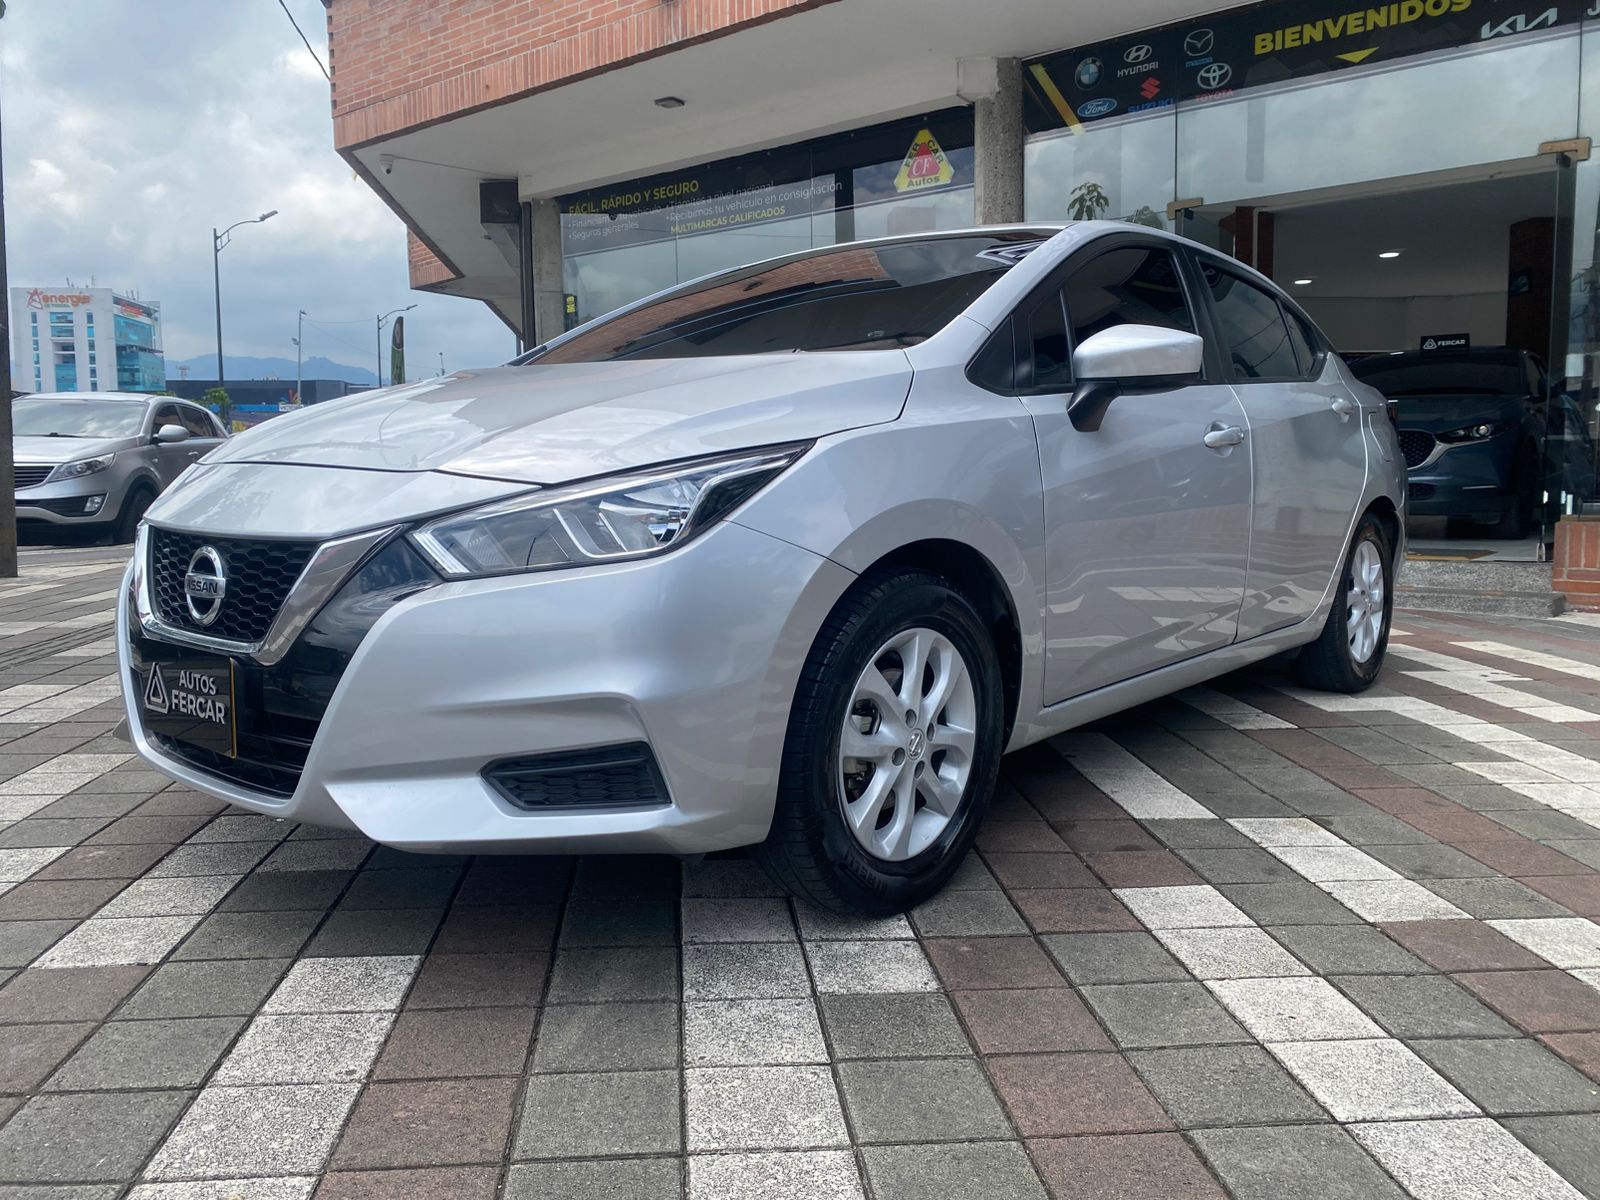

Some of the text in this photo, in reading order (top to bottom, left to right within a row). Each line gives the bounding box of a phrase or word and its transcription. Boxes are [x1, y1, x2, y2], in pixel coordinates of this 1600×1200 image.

[1254, 0, 1472, 55] BIENVENIDOS
[1117, 61, 1159, 78] HYUNDAI
[1128, 98, 1174, 113] SUZUKI
[1195, 89, 1233, 102] TOYOTA
[1084, 102, 1109, 115] Ford
[904, 139, 944, 168] FER CAR
[736, 180, 774, 197] nacional
[907, 176, 941, 188] Autos
[601, 192, 642, 211] RÁPIDO
[644, 190, 651, 202] Y
[653, 180, 699, 200] SEGURO
[670, 207, 713, 221] Recibimos
[715, 204, 724, 214] tu
[764, 193, 777, 204] en
[778, 180, 842, 202] consignación
[572, 221, 640, 241] Seguros generales
[671, 206, 785, 234] MULTIMARCAS CALIFICADOS
[179, 670, 217, 695] AUTOS
[172, 689, 225, 724] FERCAR
